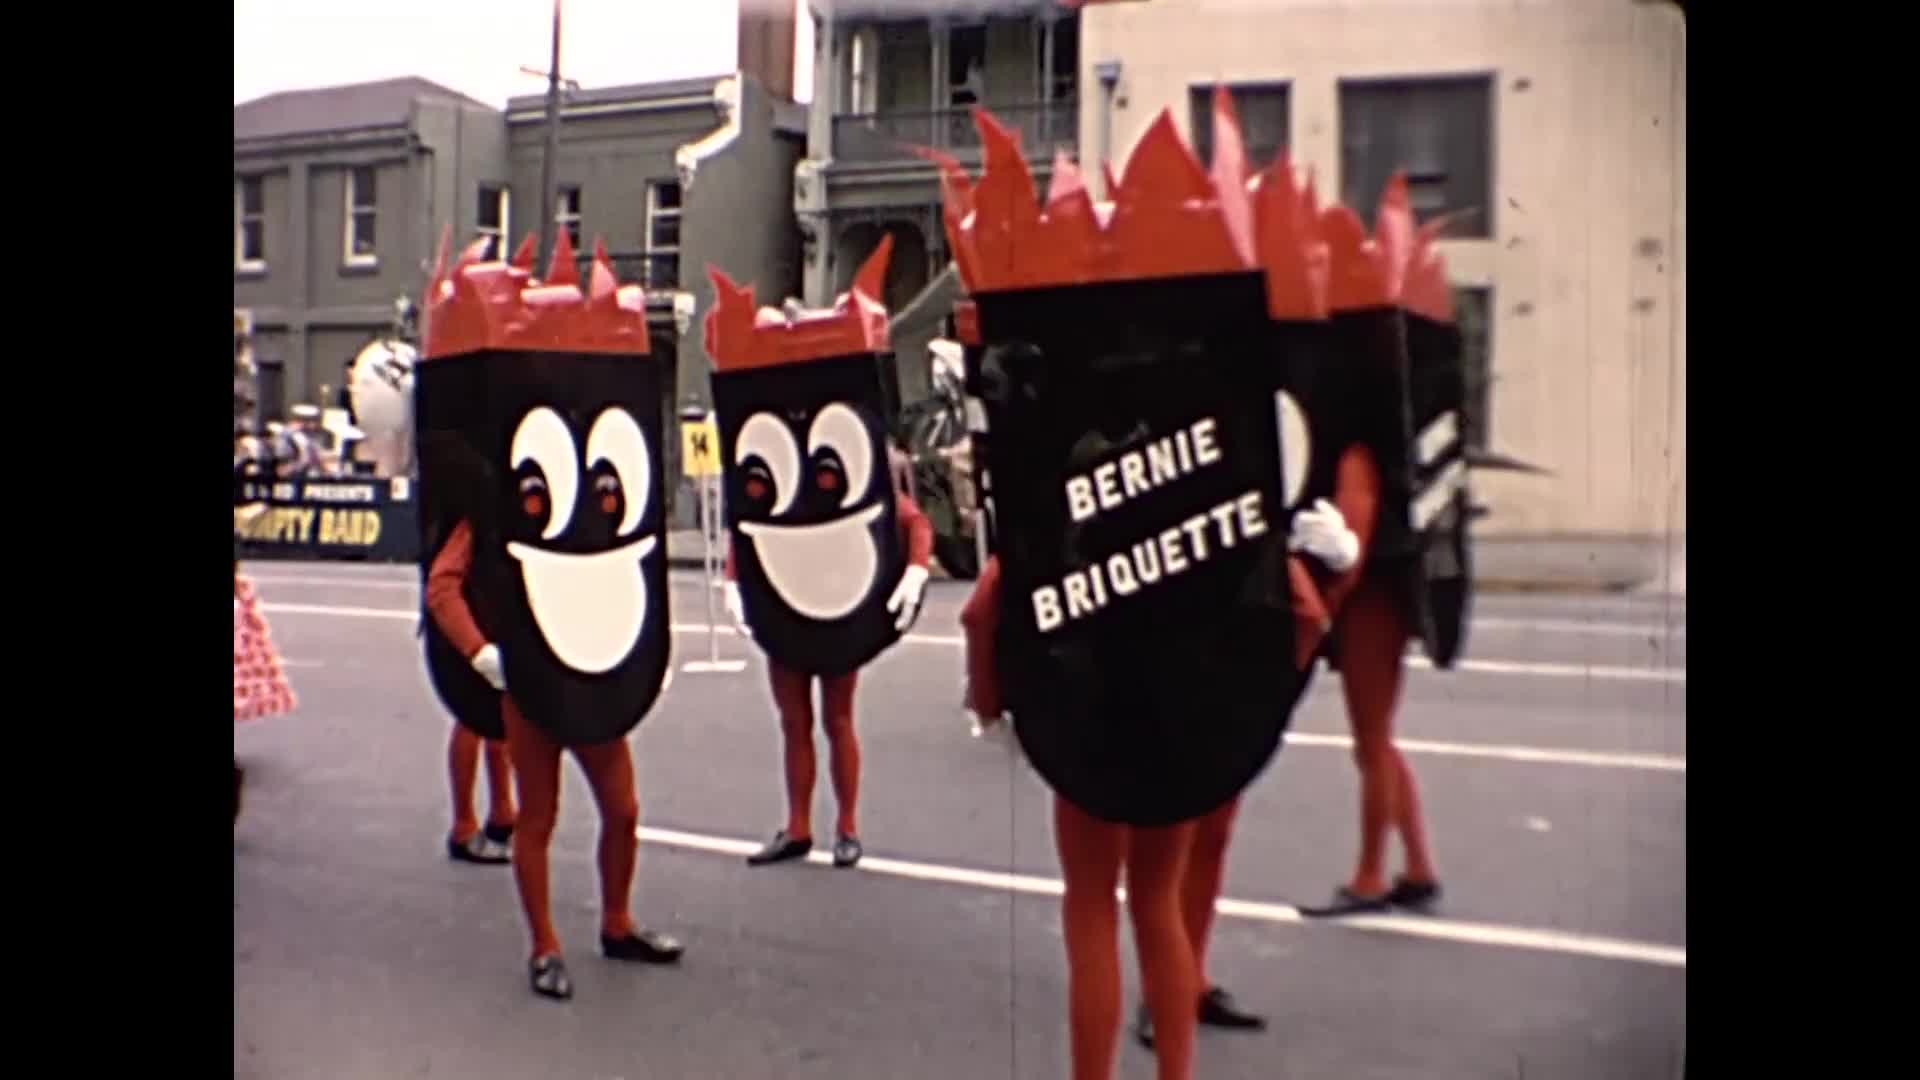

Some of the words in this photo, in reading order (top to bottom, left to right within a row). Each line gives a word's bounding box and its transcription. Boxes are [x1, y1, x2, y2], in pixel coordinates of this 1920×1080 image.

[1065, 417, 1222, 522] BERNIE
[318, 508, 381, 546] BAND
[1031, 490, 1268, 632] BRIQUETTE
